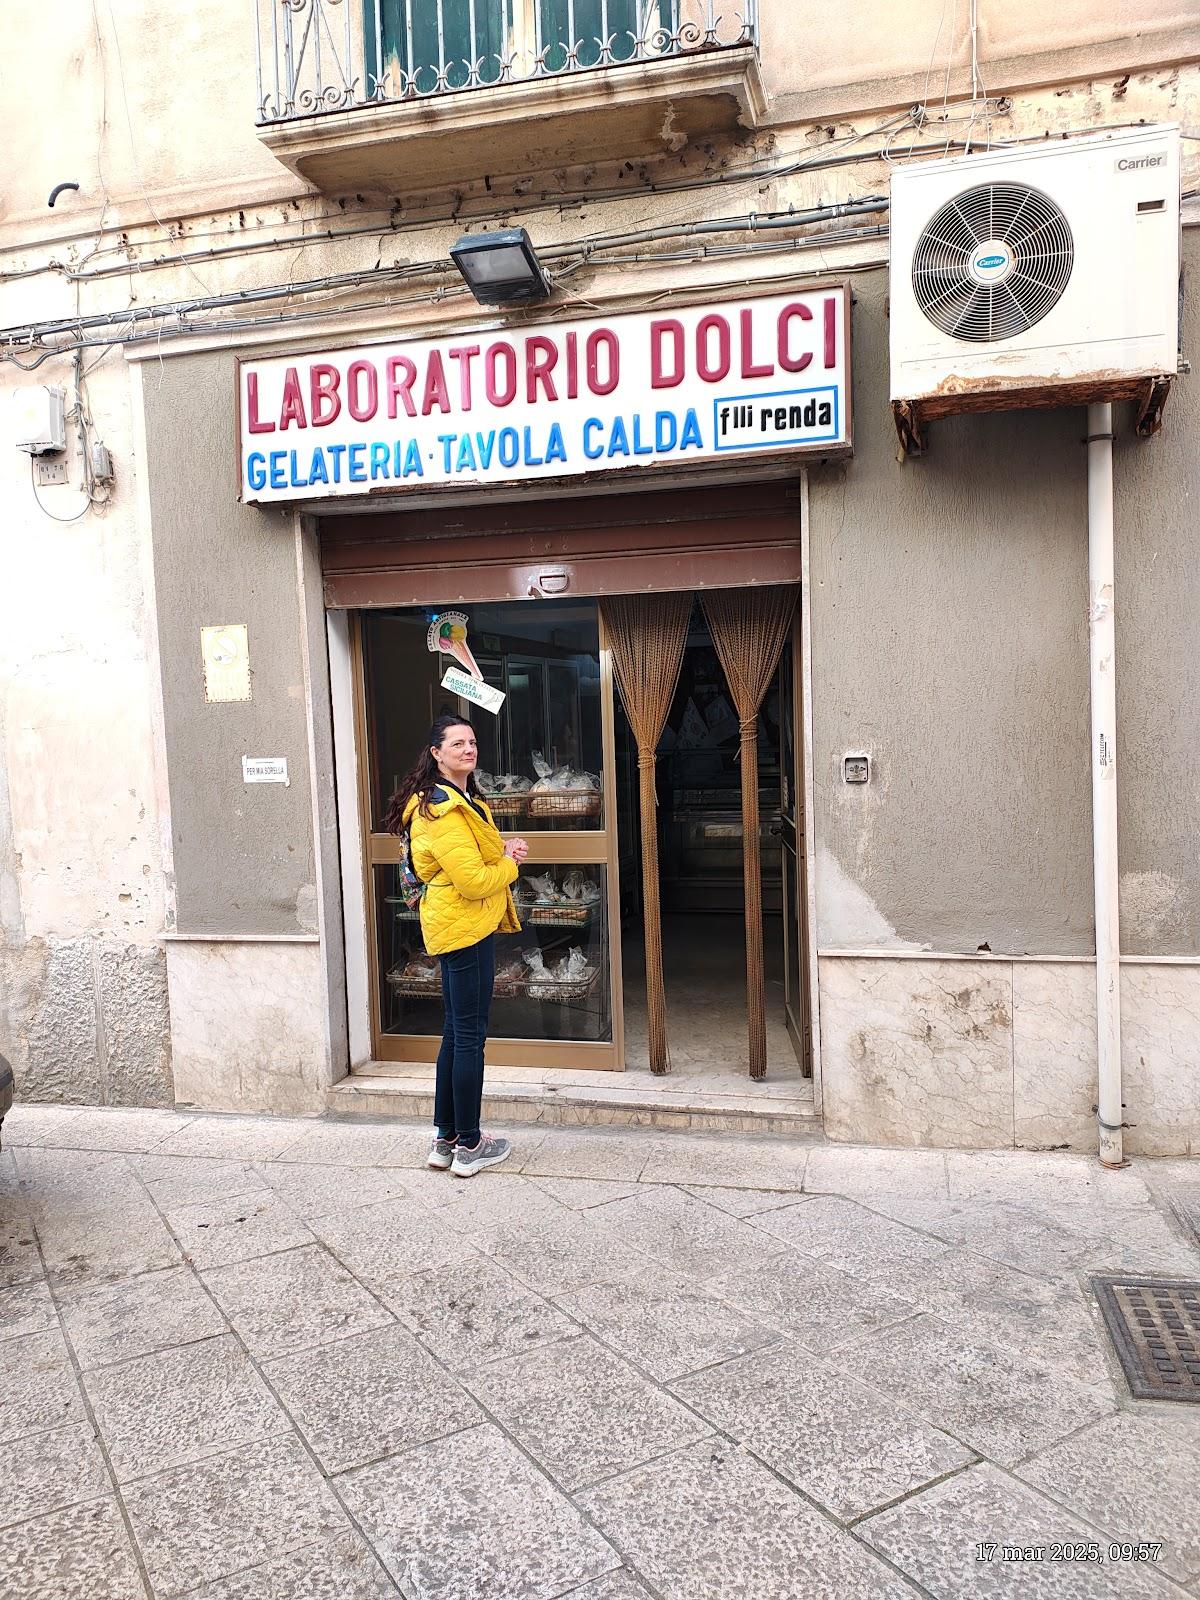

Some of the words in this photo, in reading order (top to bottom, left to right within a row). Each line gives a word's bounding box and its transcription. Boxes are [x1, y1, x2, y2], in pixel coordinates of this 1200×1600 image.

[1117, 155, 1163, 171] Carrier
[979, 256, 1004, 267] Carrier
[247, 329, 620, 434] LABORATORIO
[650, 298, 837, 390] DOLCI
[720, 405, 753, 435] flli
[760, 398, 831, 432] renda
[246, 437, 424, 491] GELATERIA
[436, 421, 568, 474] TAVOLA
[582, 408, 704, 459] CALDA
[445, 676, 477, 692] CASSATA
[450, 684, 482, 701] SICILIANA
[246, 767, 255, 775] PER
[265, 766, 285, 774] SORELLA
